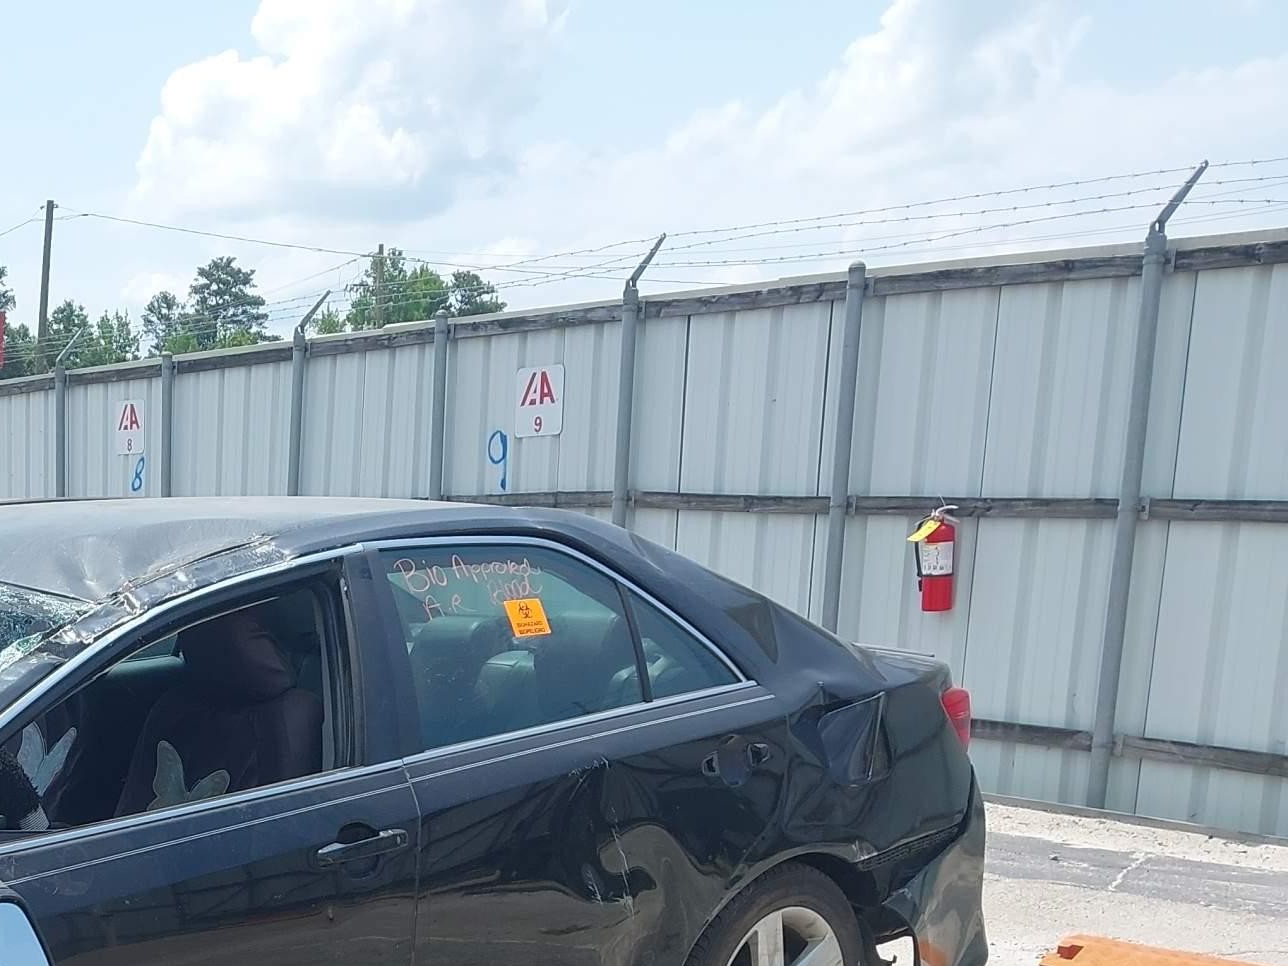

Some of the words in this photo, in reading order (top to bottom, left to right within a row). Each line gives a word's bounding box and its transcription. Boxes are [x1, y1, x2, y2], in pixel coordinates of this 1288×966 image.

[534, 416, 543, 433] 9
[127, 438, 133, 452] 8
[488, 430, 508, 492] 9
[131, 457, 145, 492] 8
[393, 558, 448, 592] Bio
